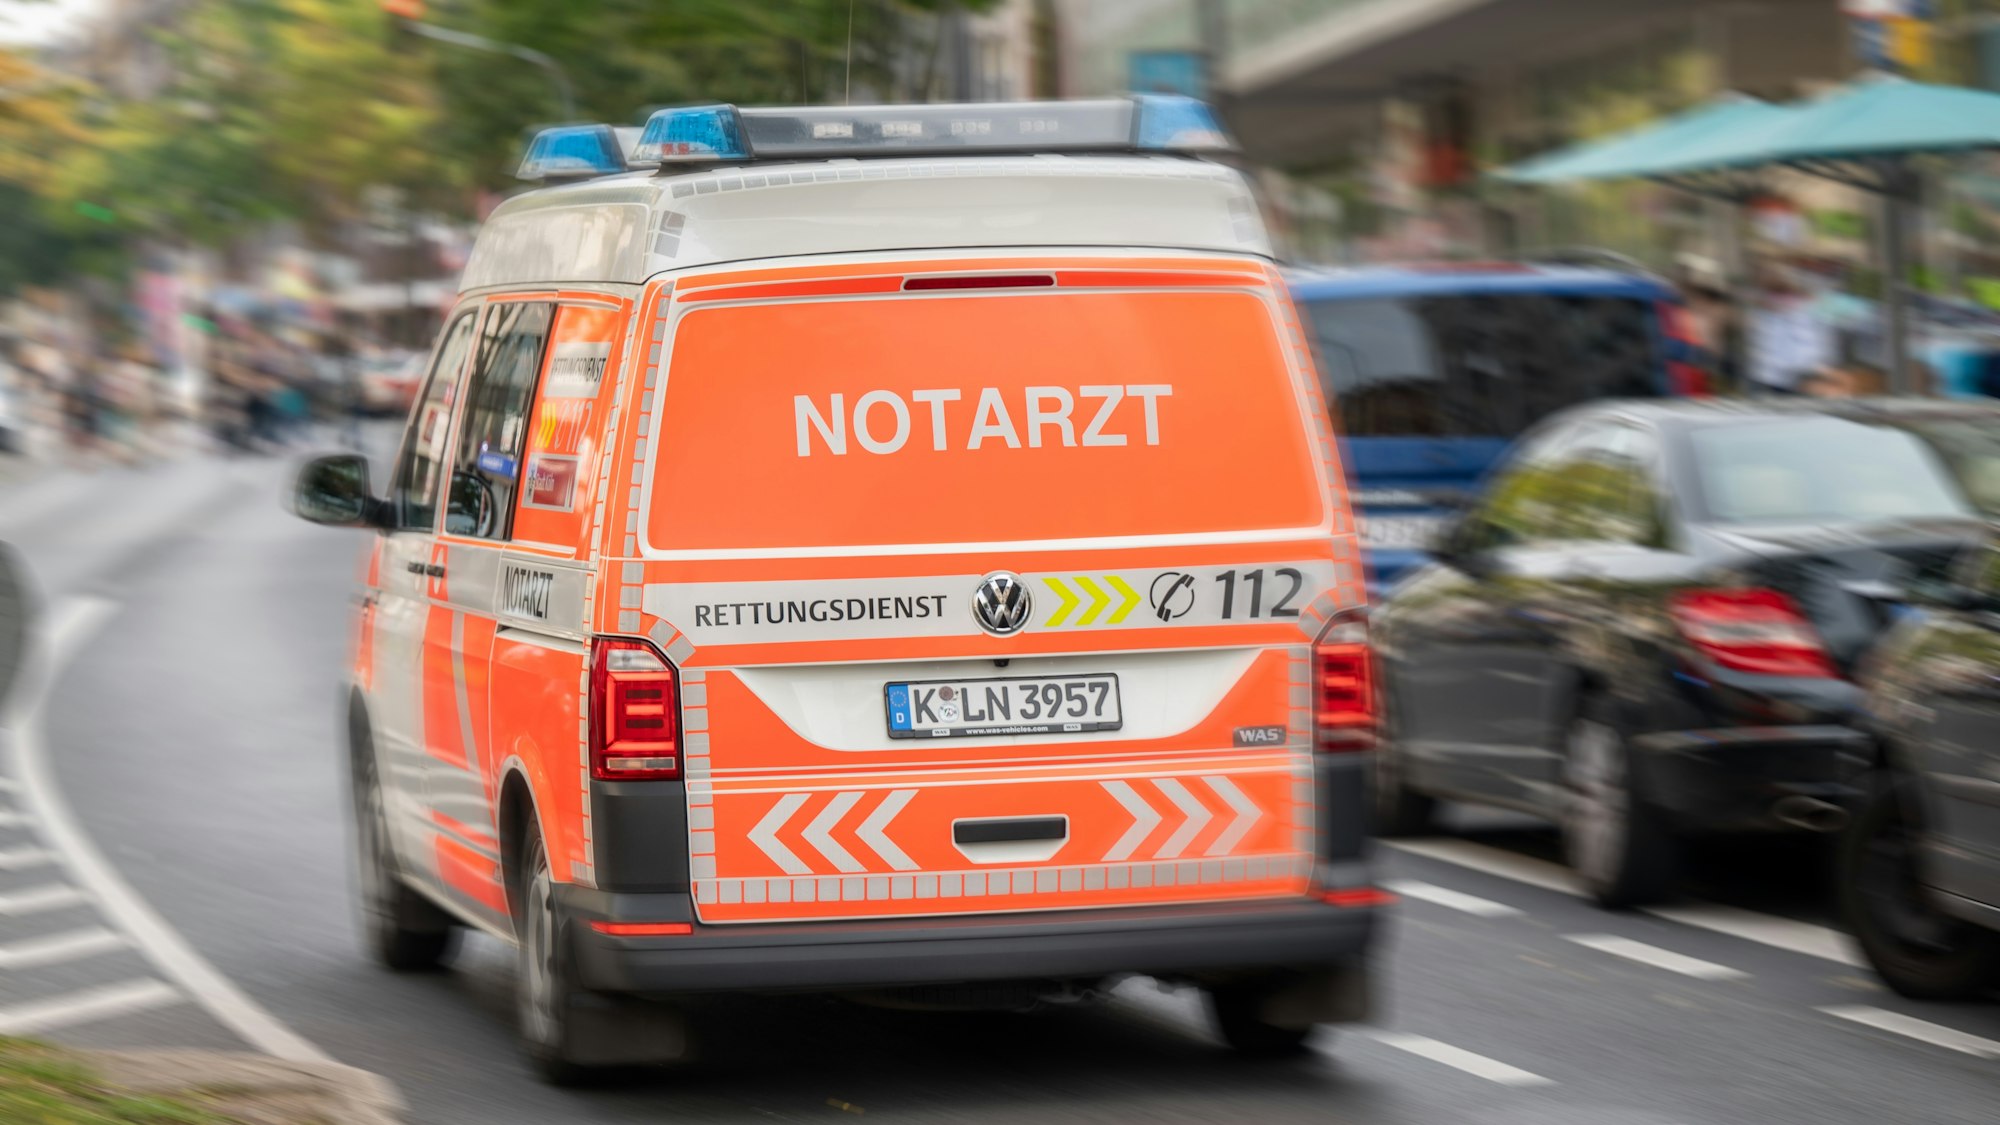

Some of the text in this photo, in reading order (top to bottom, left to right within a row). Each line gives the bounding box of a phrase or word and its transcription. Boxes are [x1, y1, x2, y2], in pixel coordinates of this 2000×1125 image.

[793, 384, 1173, 457] NOTARZT
[502, 566, 553, 619] NOTARZT
[1215, 568, 1303, 619] 112
[695, 595, 947, 627] RETTUNGSDIENST
[896, 712, 904, 723] D
[961, 686, 1011, 721] LN
[1019, 681, 1109, 719] 3957
[966, 725, 1049, 735] www.was-vehicles.com
[1239, 728, 1279, 742] WAS
